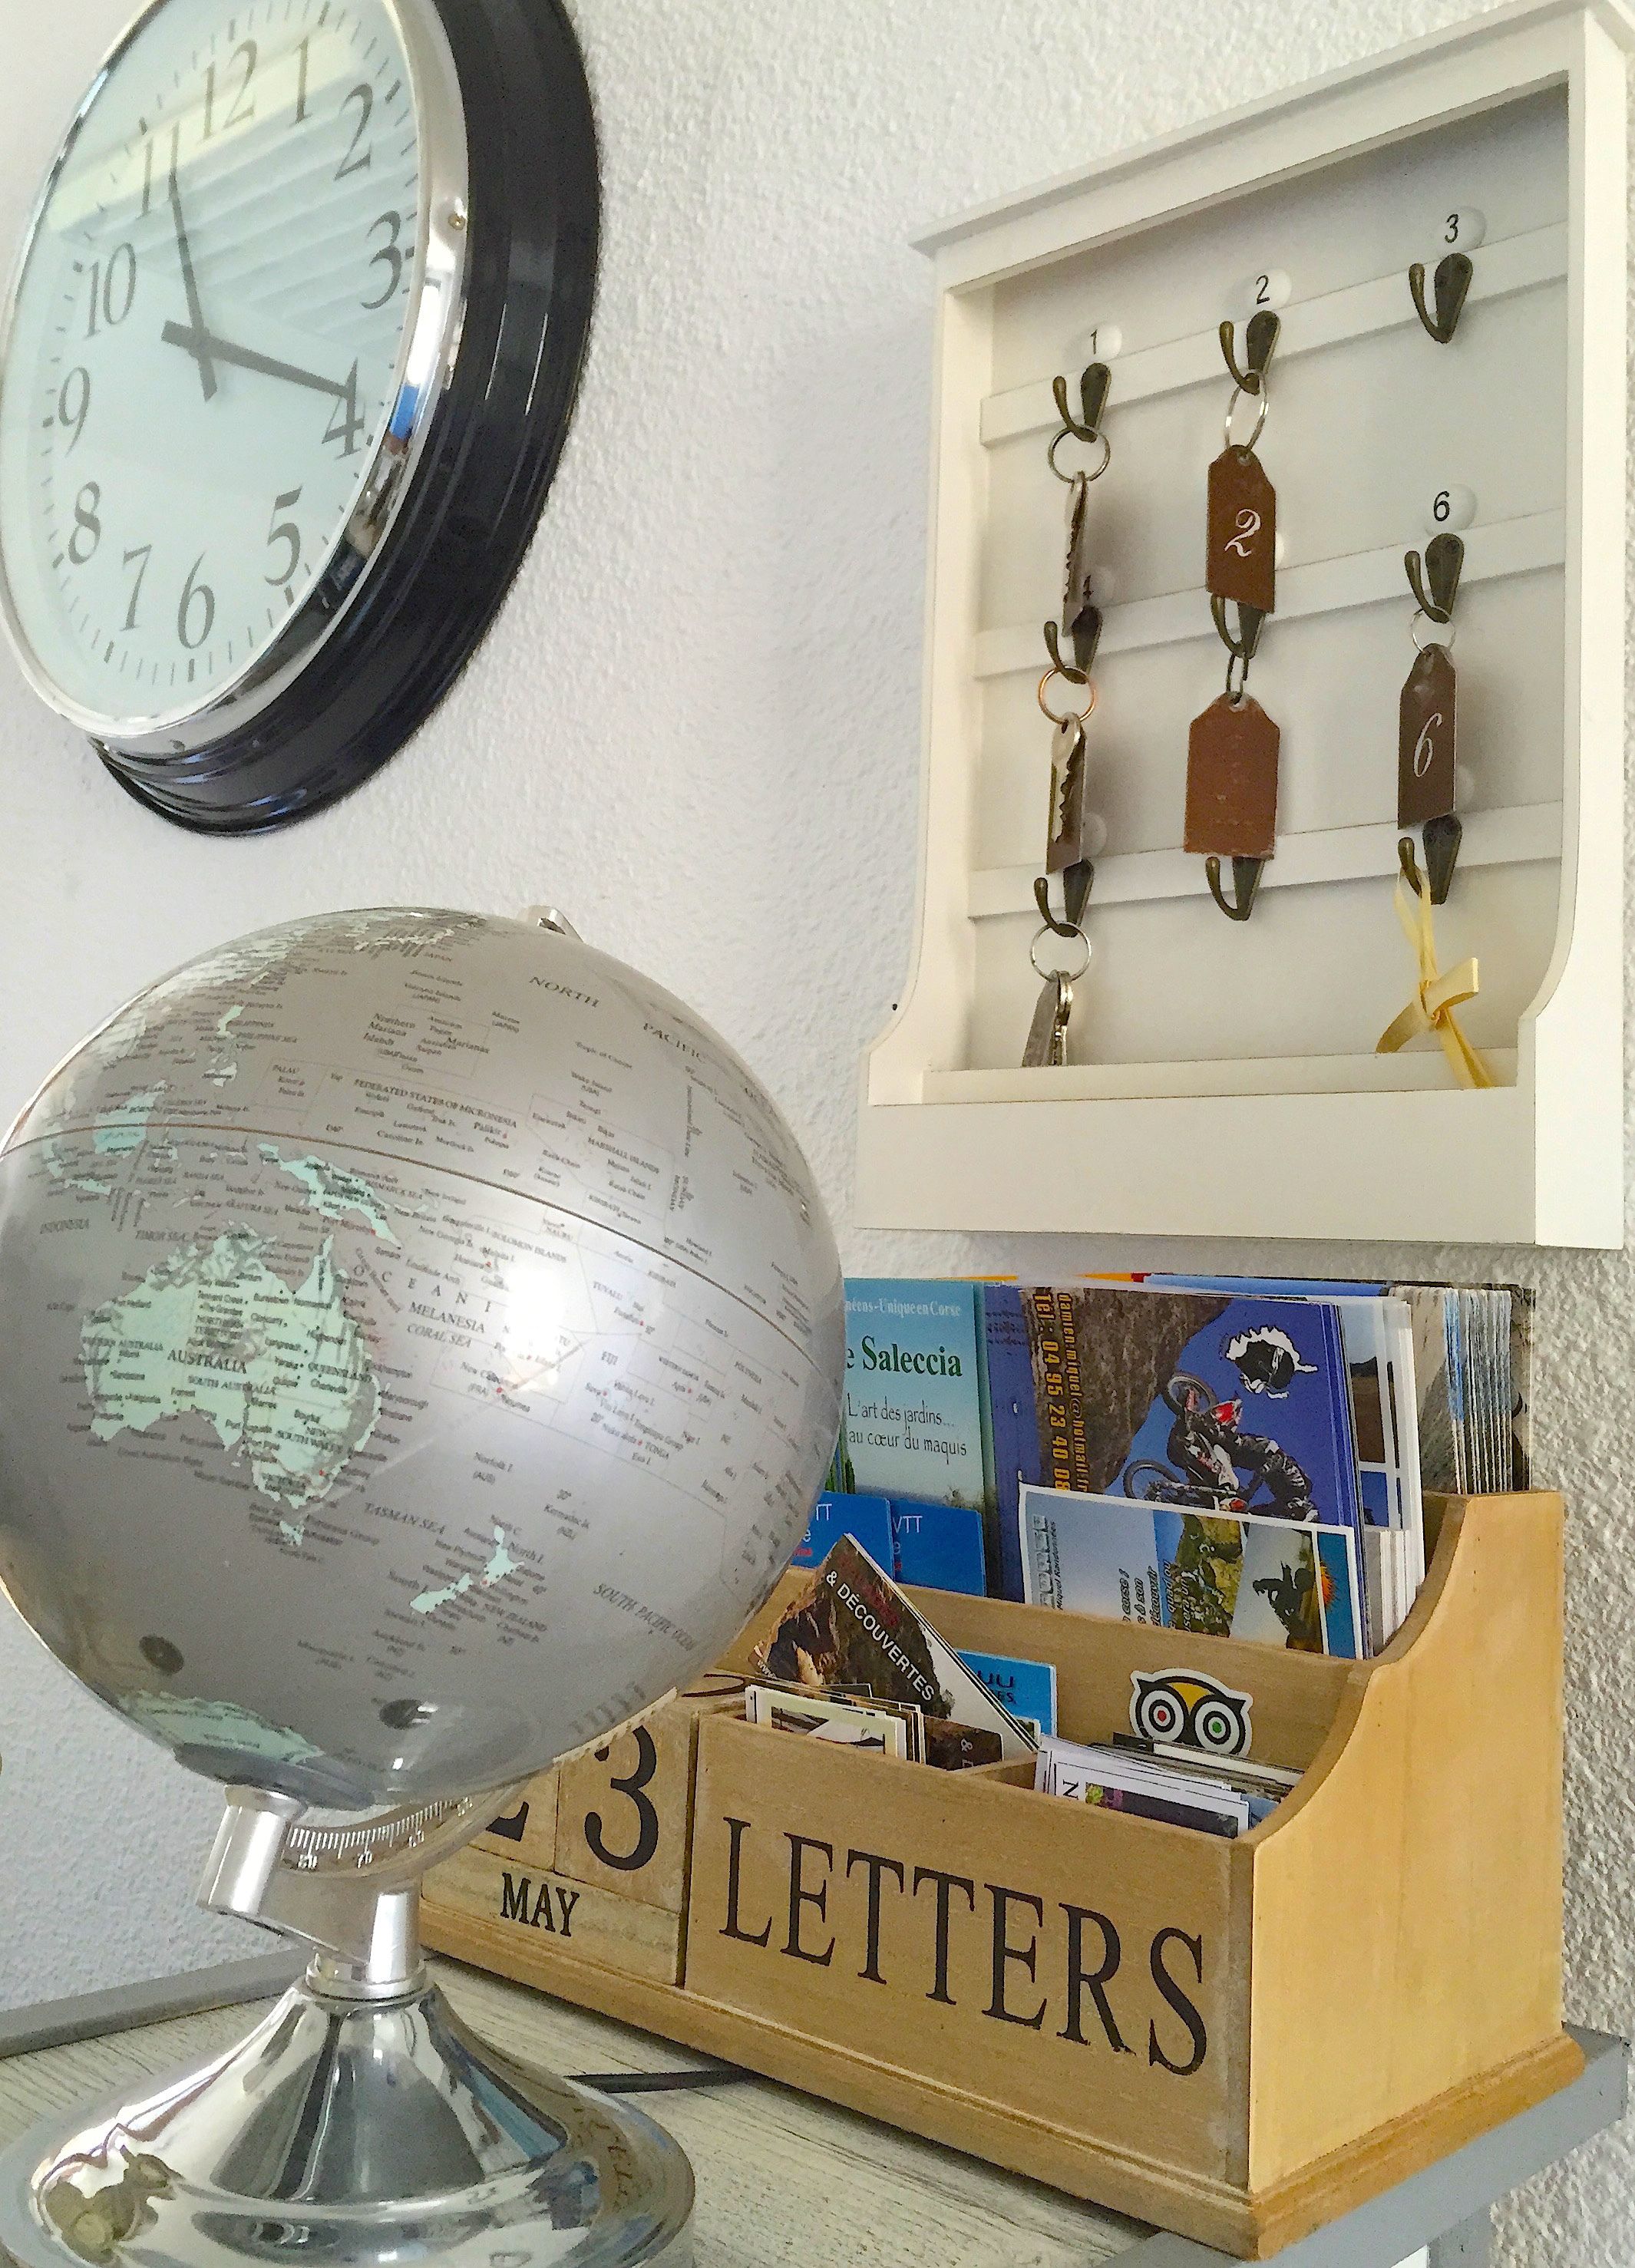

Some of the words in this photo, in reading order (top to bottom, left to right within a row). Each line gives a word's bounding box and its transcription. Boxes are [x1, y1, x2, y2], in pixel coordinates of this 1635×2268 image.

[203, 40, 257, 139] 12
[289, 40, 314, 128] 1
[334, 84, 374, 180] 2
[134, 124, 180, 220] 11
[1445, 214, 1460, 243] 3
[362, 210, 401, 309] 3
[84, 243, 137, 338] 10
[1255, 276, 1272, 305] 2
[1089, 332, 1098, 355] 1
[58, 367, 91, 454] 9
[322, 358, 365, 458] 4
[68, 481, 101, 565] 8
[1224, 509, 1262, 558] 2
[1432, 492, 1451, 522] 6
[266, 485, 302, 586] 5
[121, 544, 152, 631] 7
[177, 550, 215, 649] 6
[1413, 713, 1443, 777] 6
[530, 976, 600, 1008] NORTH
[408, 1301, 485, 1333] MELANESIA
[167, 1349, 246, 1374] AUSTRALIA
[861, 1335, 963, 1377] Saleccia
[1042, 1340, 1060, 1364] 04
[847, 1392, 877, 1418] L'art
[880, 1395, 901, 1421] des
[1045, 1372, 1065, 1397] 95
[1048, 1403, 1066, 1428] 23
[849, 1431, 863, 1444] au
[867, 1433, 900, 1448] cœur
[904, 1426, 920, 1451] du
[923, 1438, 967, 1465] maquis
[1052, 1435, 1069, 1460] 40
[1053, 1467, 1071, 1491] 08
[593, 1583, 637, 1611] SOUTH
[826, 1570, 837, 1587] &
[837, 1583, 935, 1701] DÉCOUVERTES
[584, 1725, 659, 1871] 3
[500, 1873, 580, 1936] MAY
[720, 1817, 1207, 2077] LETTERS
